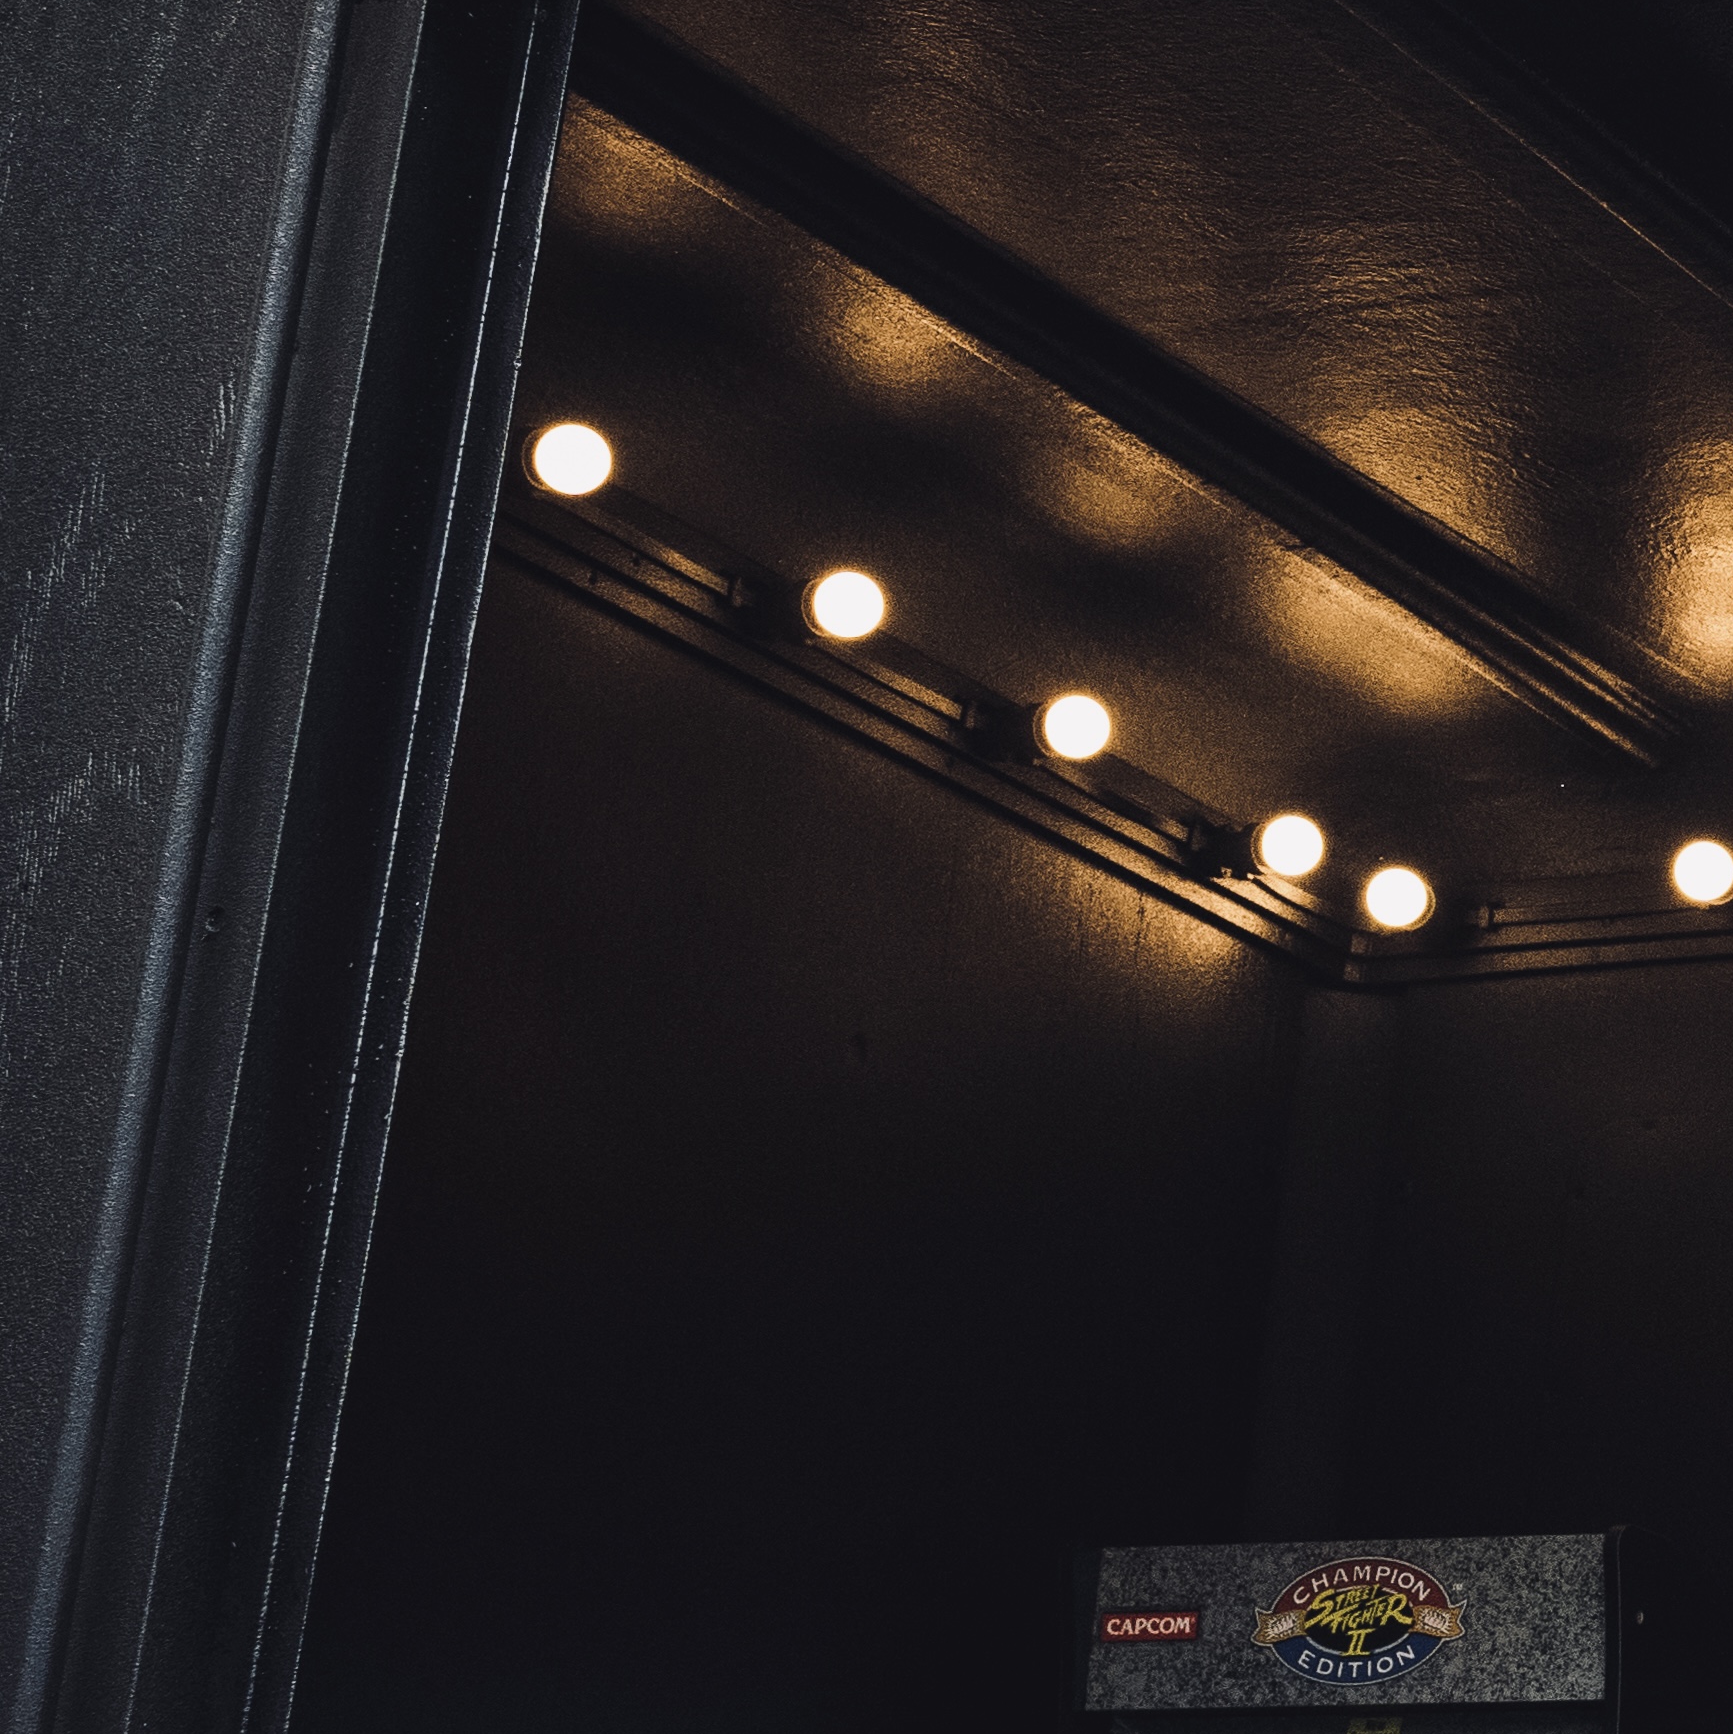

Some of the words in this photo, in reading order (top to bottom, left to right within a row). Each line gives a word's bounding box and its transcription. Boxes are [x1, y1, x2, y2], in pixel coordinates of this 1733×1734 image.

[1293, 1565, 1432, 1605] CHAMPION
[1304, 1584, 1380, 1629] STREET
[1322, 1592, 1414, 1634] FIGHTER
[1105, 1615, 1192, 1636] CAPCOM
[1341, 1627, 1375, 1657] II
[1298, 1644, 1416, 1679] EDITION
